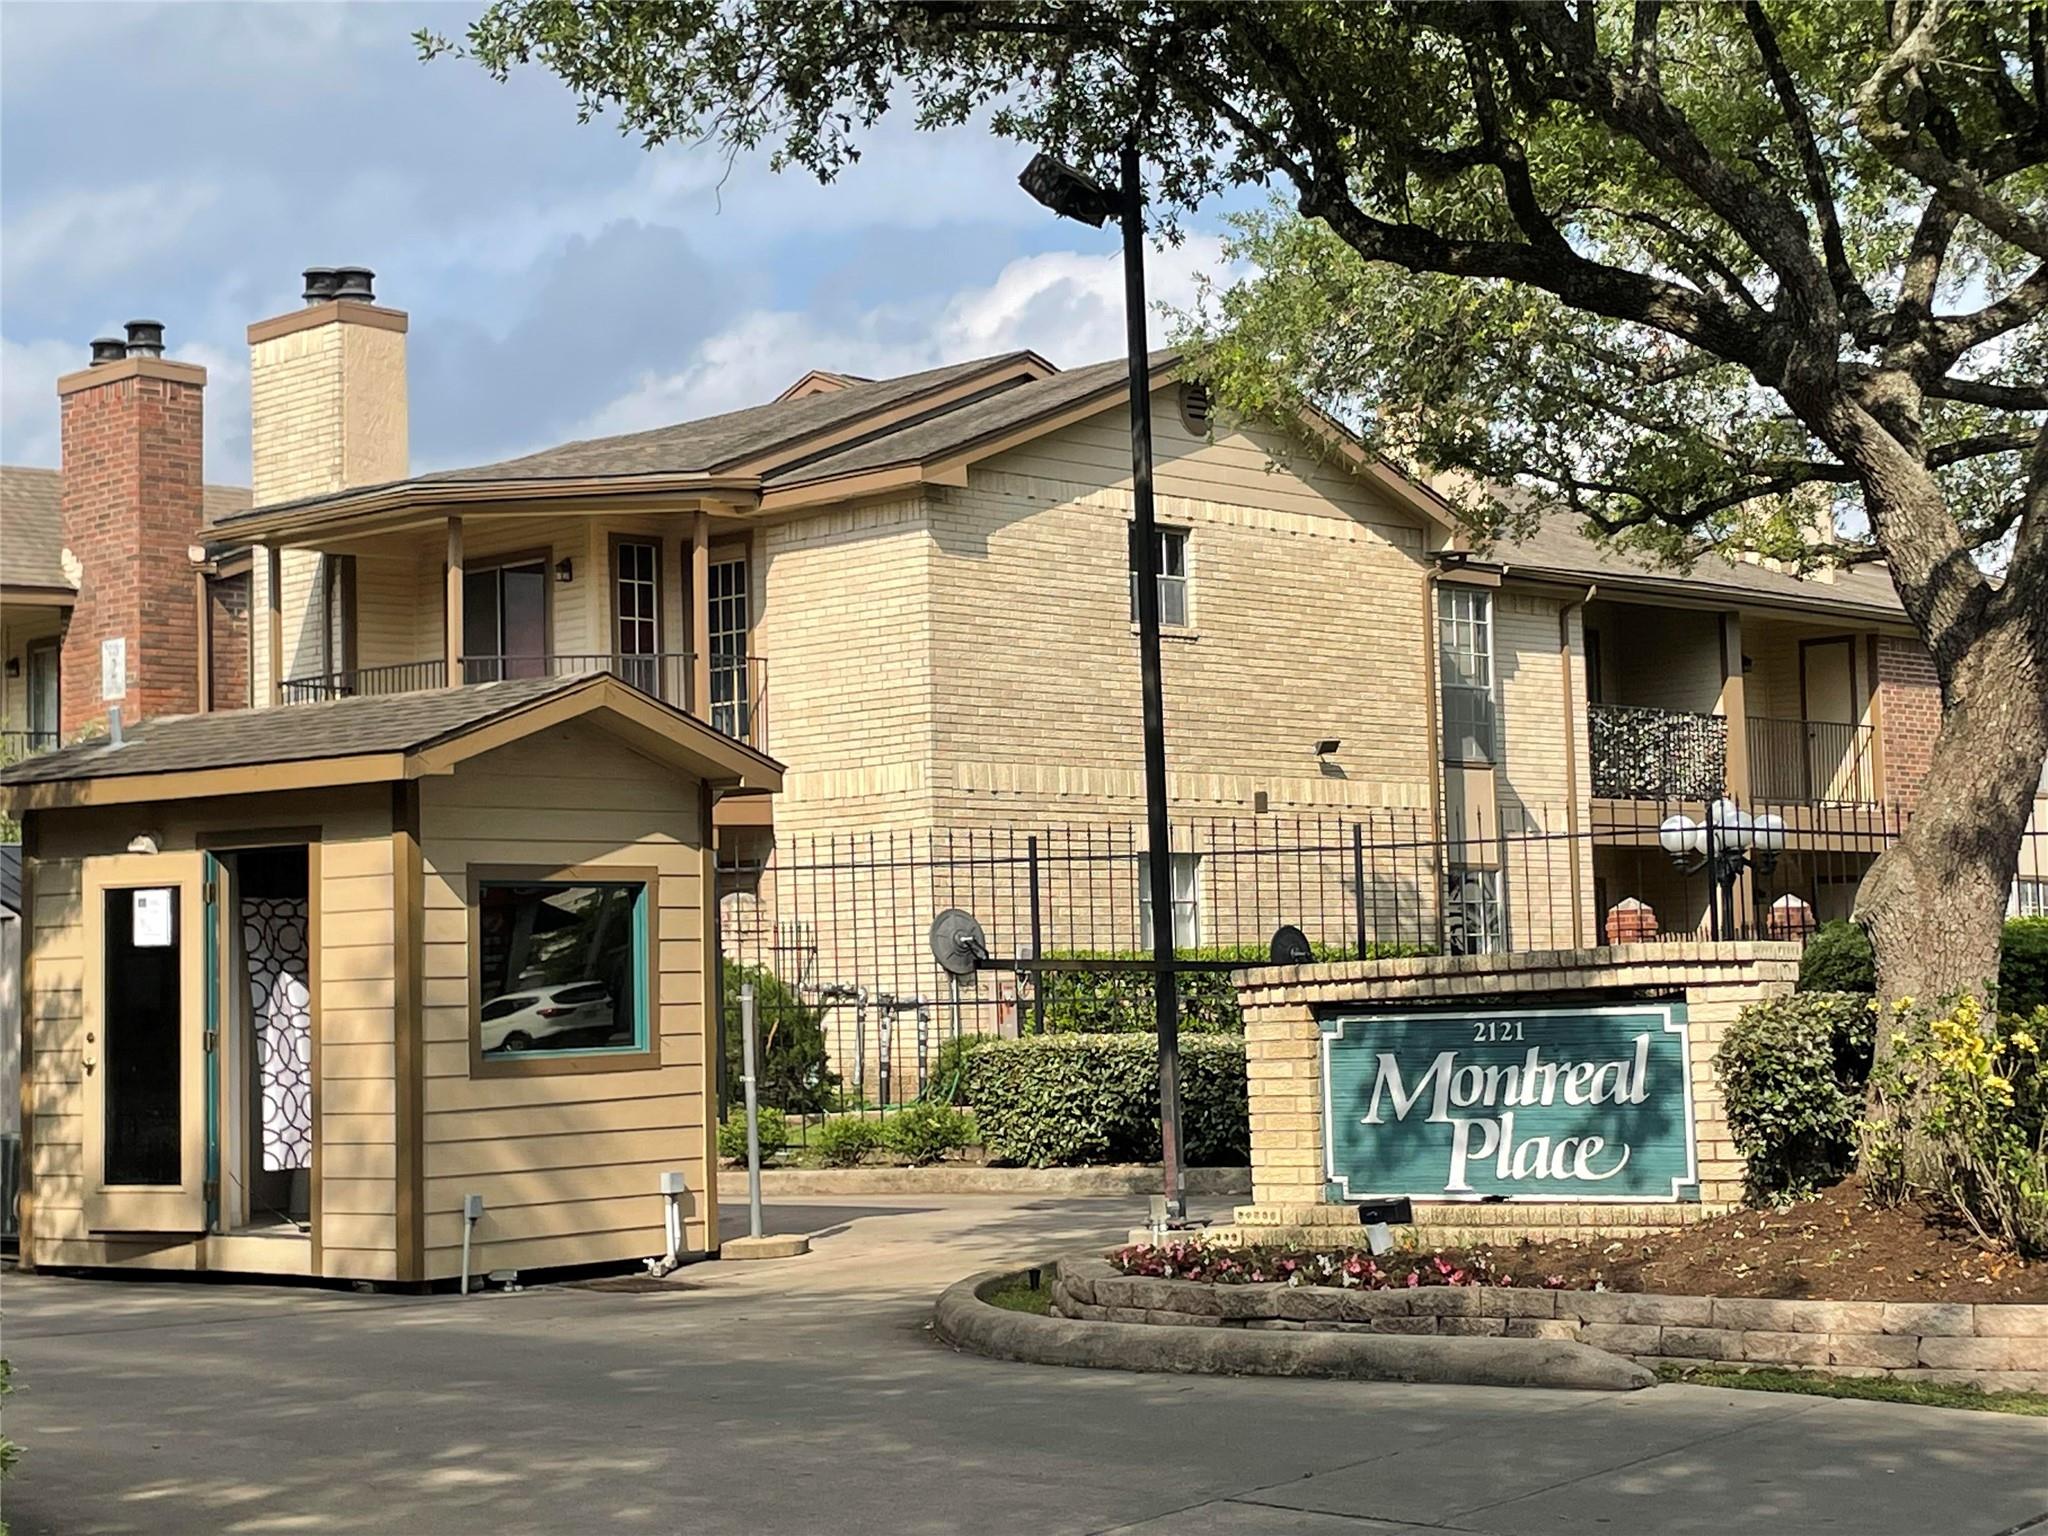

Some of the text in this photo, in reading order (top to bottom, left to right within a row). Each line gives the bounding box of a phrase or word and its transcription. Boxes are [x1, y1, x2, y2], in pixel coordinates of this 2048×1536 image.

[1473, 1022, 1525, 1042] 2121
[1361, 1034, 1650, 1124] Montreal
[1444, 1112, 1630, 1191] Place
